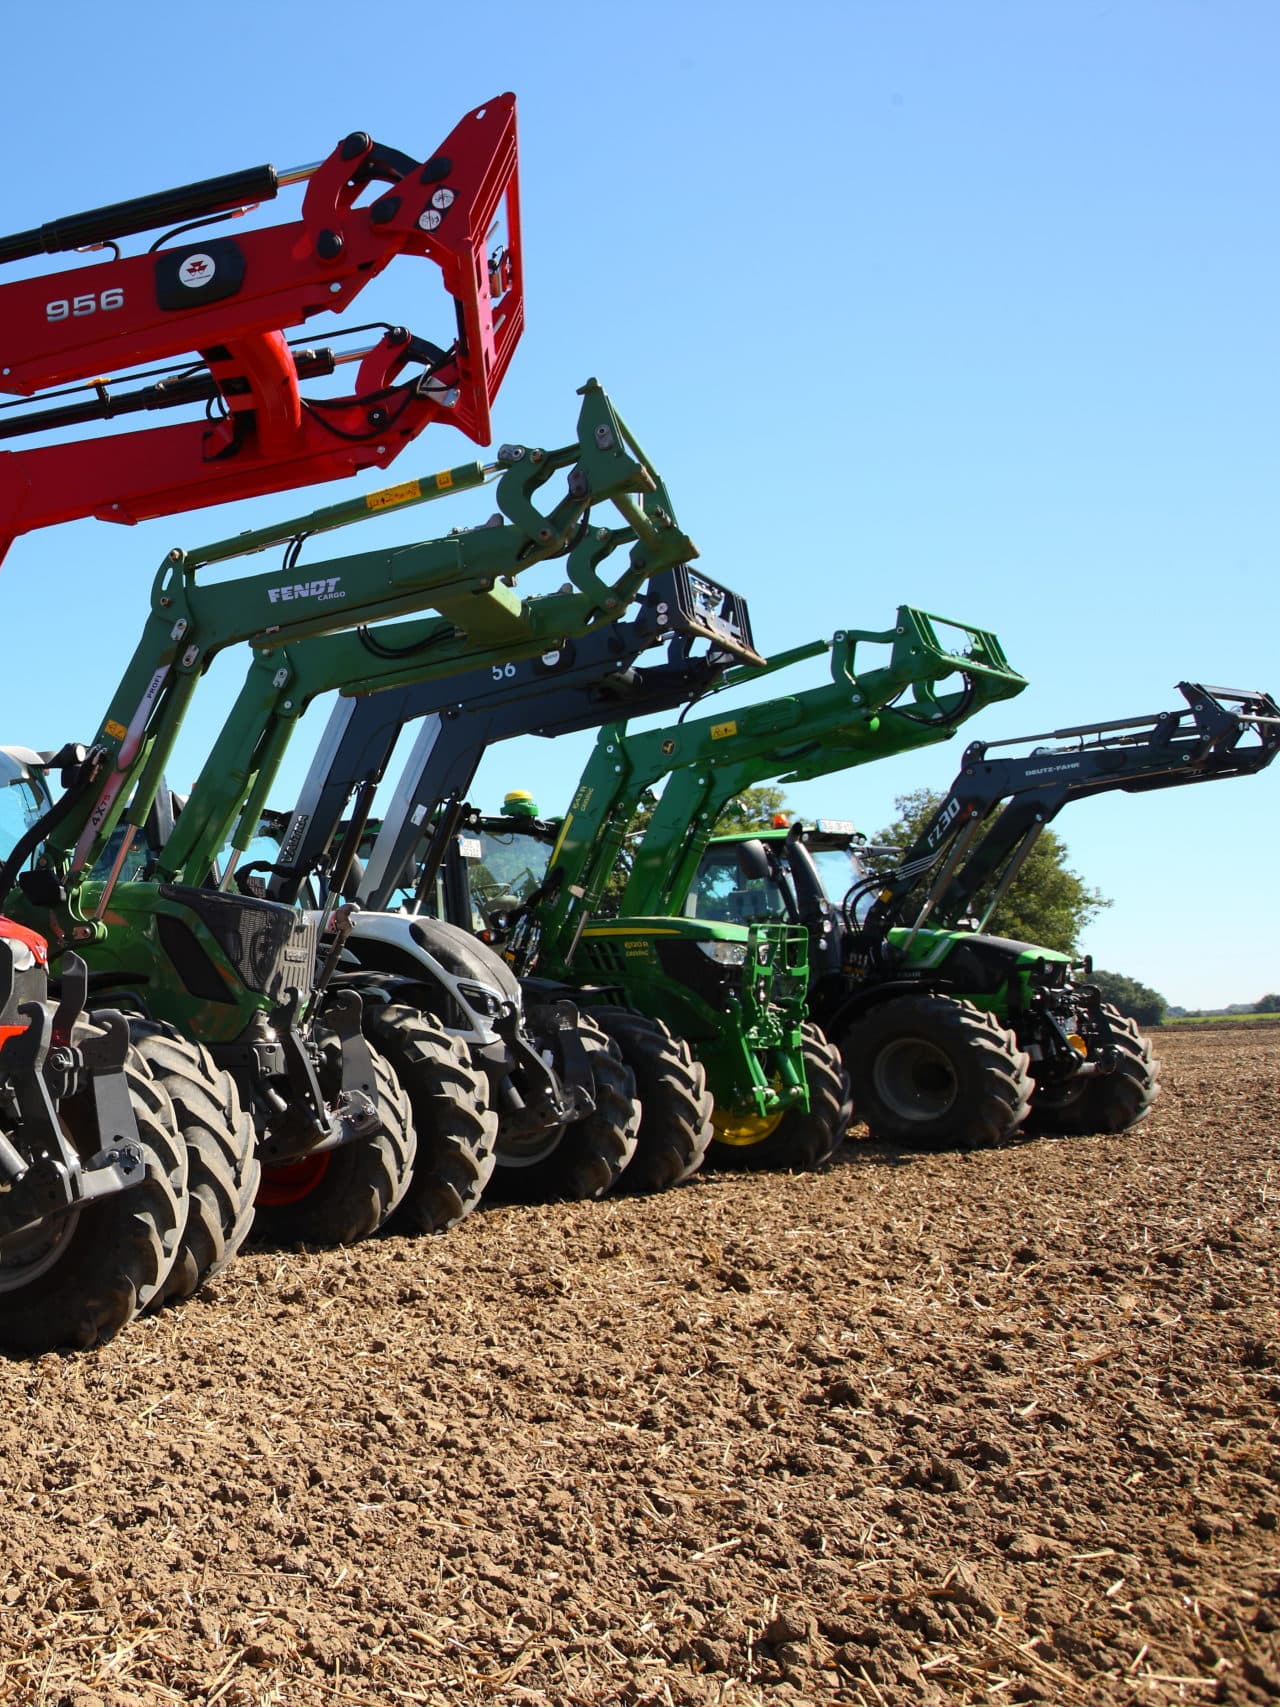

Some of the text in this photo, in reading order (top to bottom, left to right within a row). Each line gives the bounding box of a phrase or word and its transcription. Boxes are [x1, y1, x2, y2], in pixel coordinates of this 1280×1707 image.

[46, 288, 124, 322] 956
[267, 577, 341, 603] FENDT
[318, 591, 346, 601] CARGO
[146, 675, 162, 699] PROFI
[1025, 762, 1080, 776] DEUTZ-FAHR
[927, 797, 960, 848] FZ30
